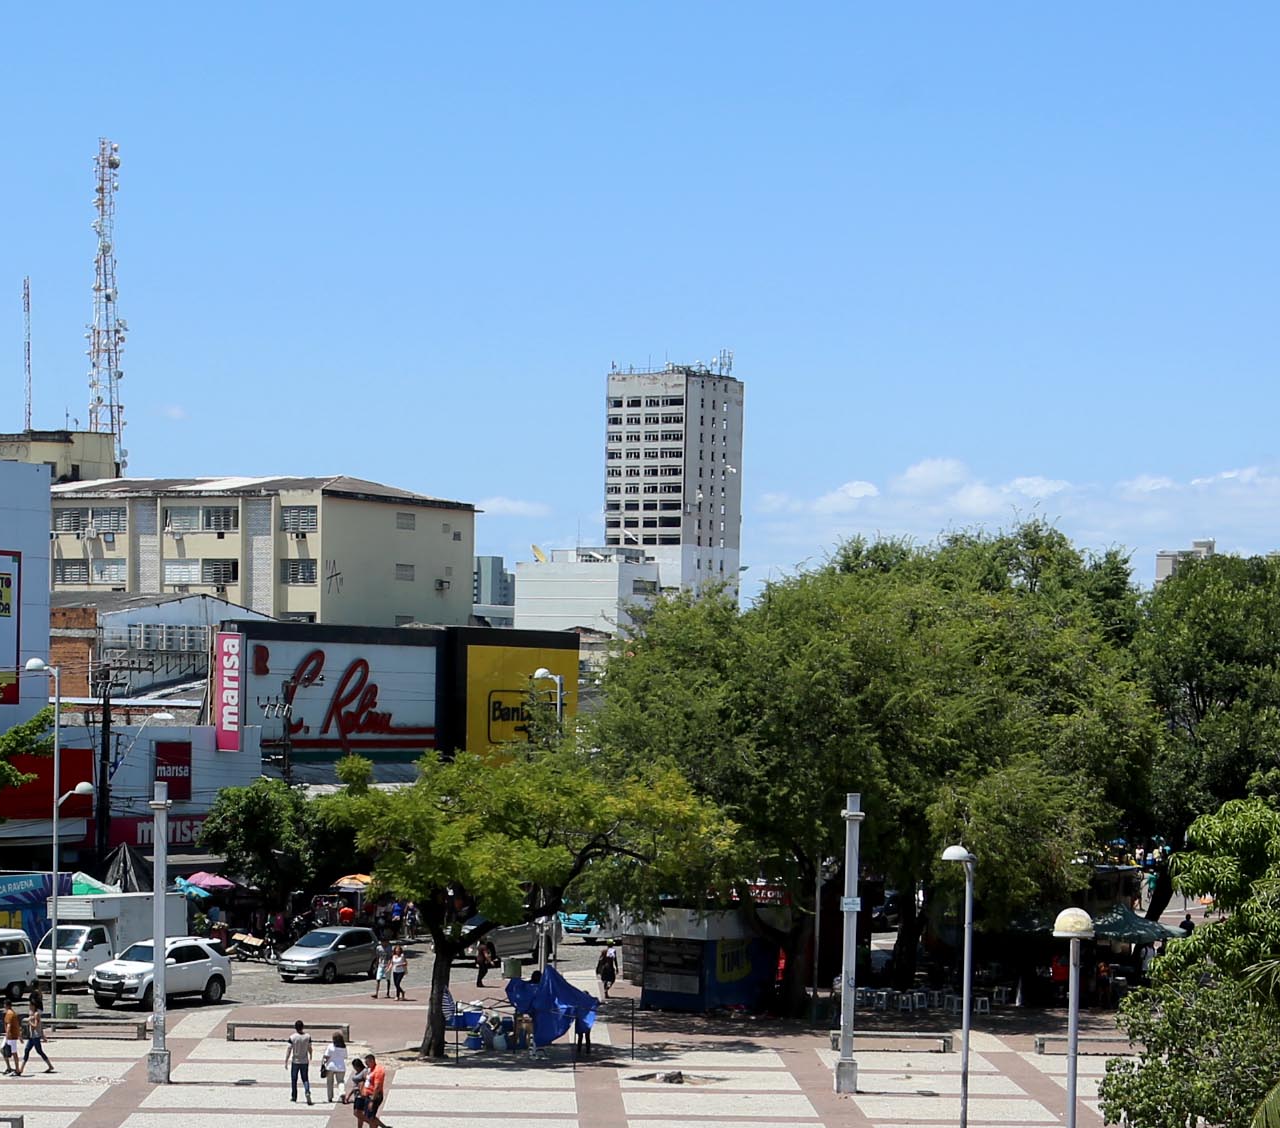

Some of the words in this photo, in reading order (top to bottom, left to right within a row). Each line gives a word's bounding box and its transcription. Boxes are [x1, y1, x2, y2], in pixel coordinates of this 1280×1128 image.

[222, 638, 240, 732] marisa
[156, 765, 189, 777] marisa
[136, 820, 204, 844] mrisa
[7, 879, 34, 893] RAVENA
